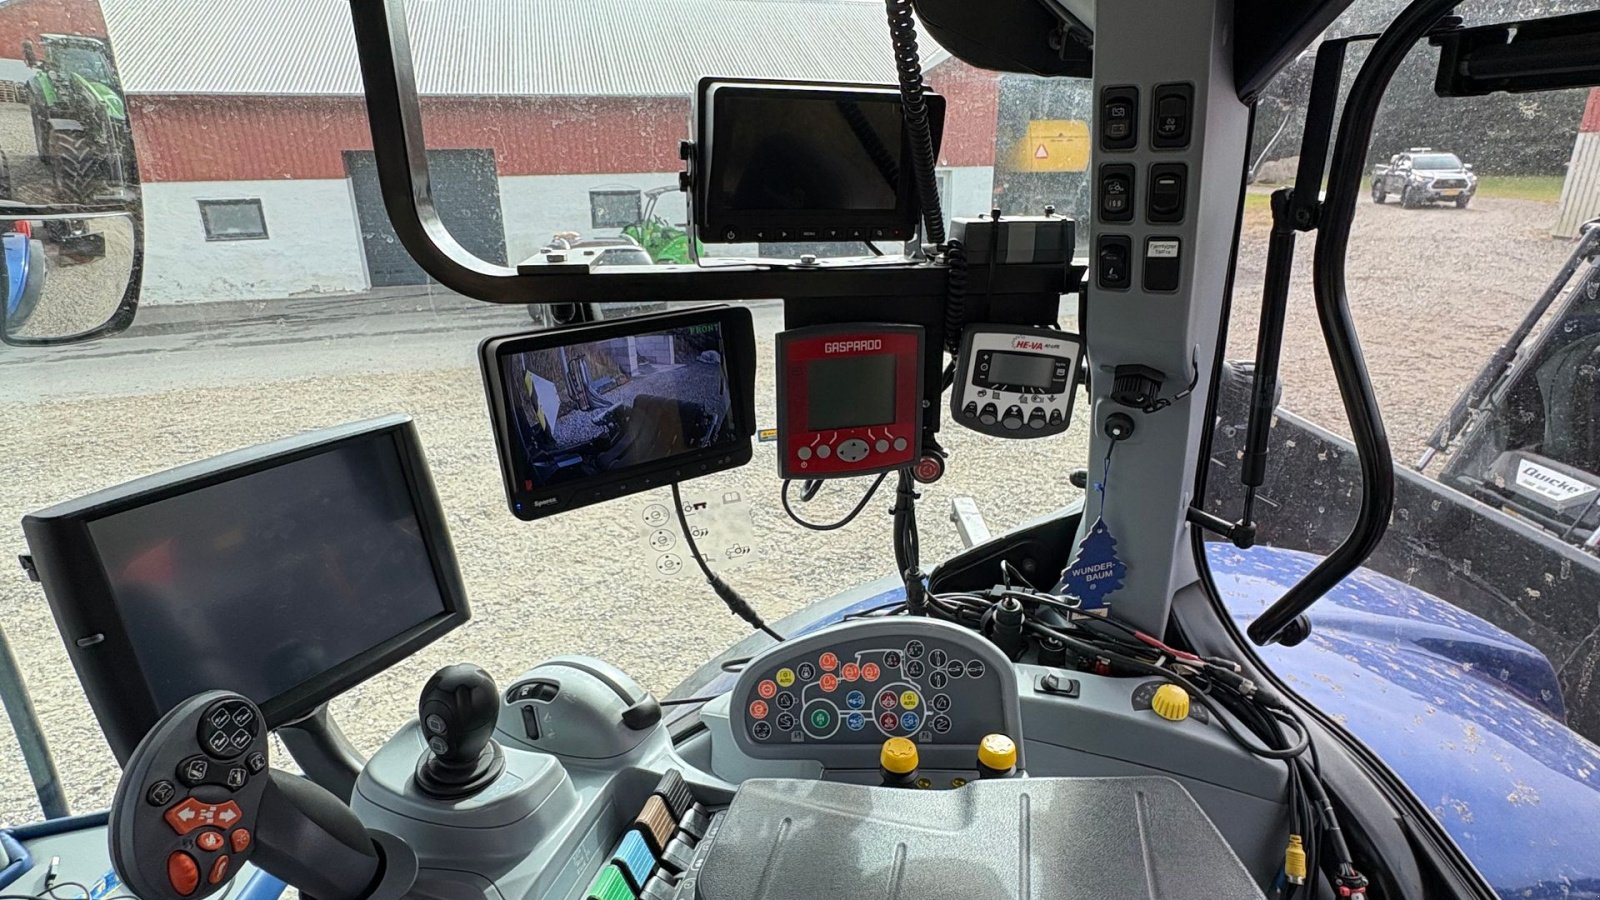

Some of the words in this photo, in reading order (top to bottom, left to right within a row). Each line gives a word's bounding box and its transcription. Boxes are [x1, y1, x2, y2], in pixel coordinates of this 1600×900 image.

[825, 340, 881, 353] GASPARDO
[1016, 341, 1043, 350] HE-VA
[1523, 467, 1580, 493] Quicke
[1086, 570, 1113, 582] BAUM
